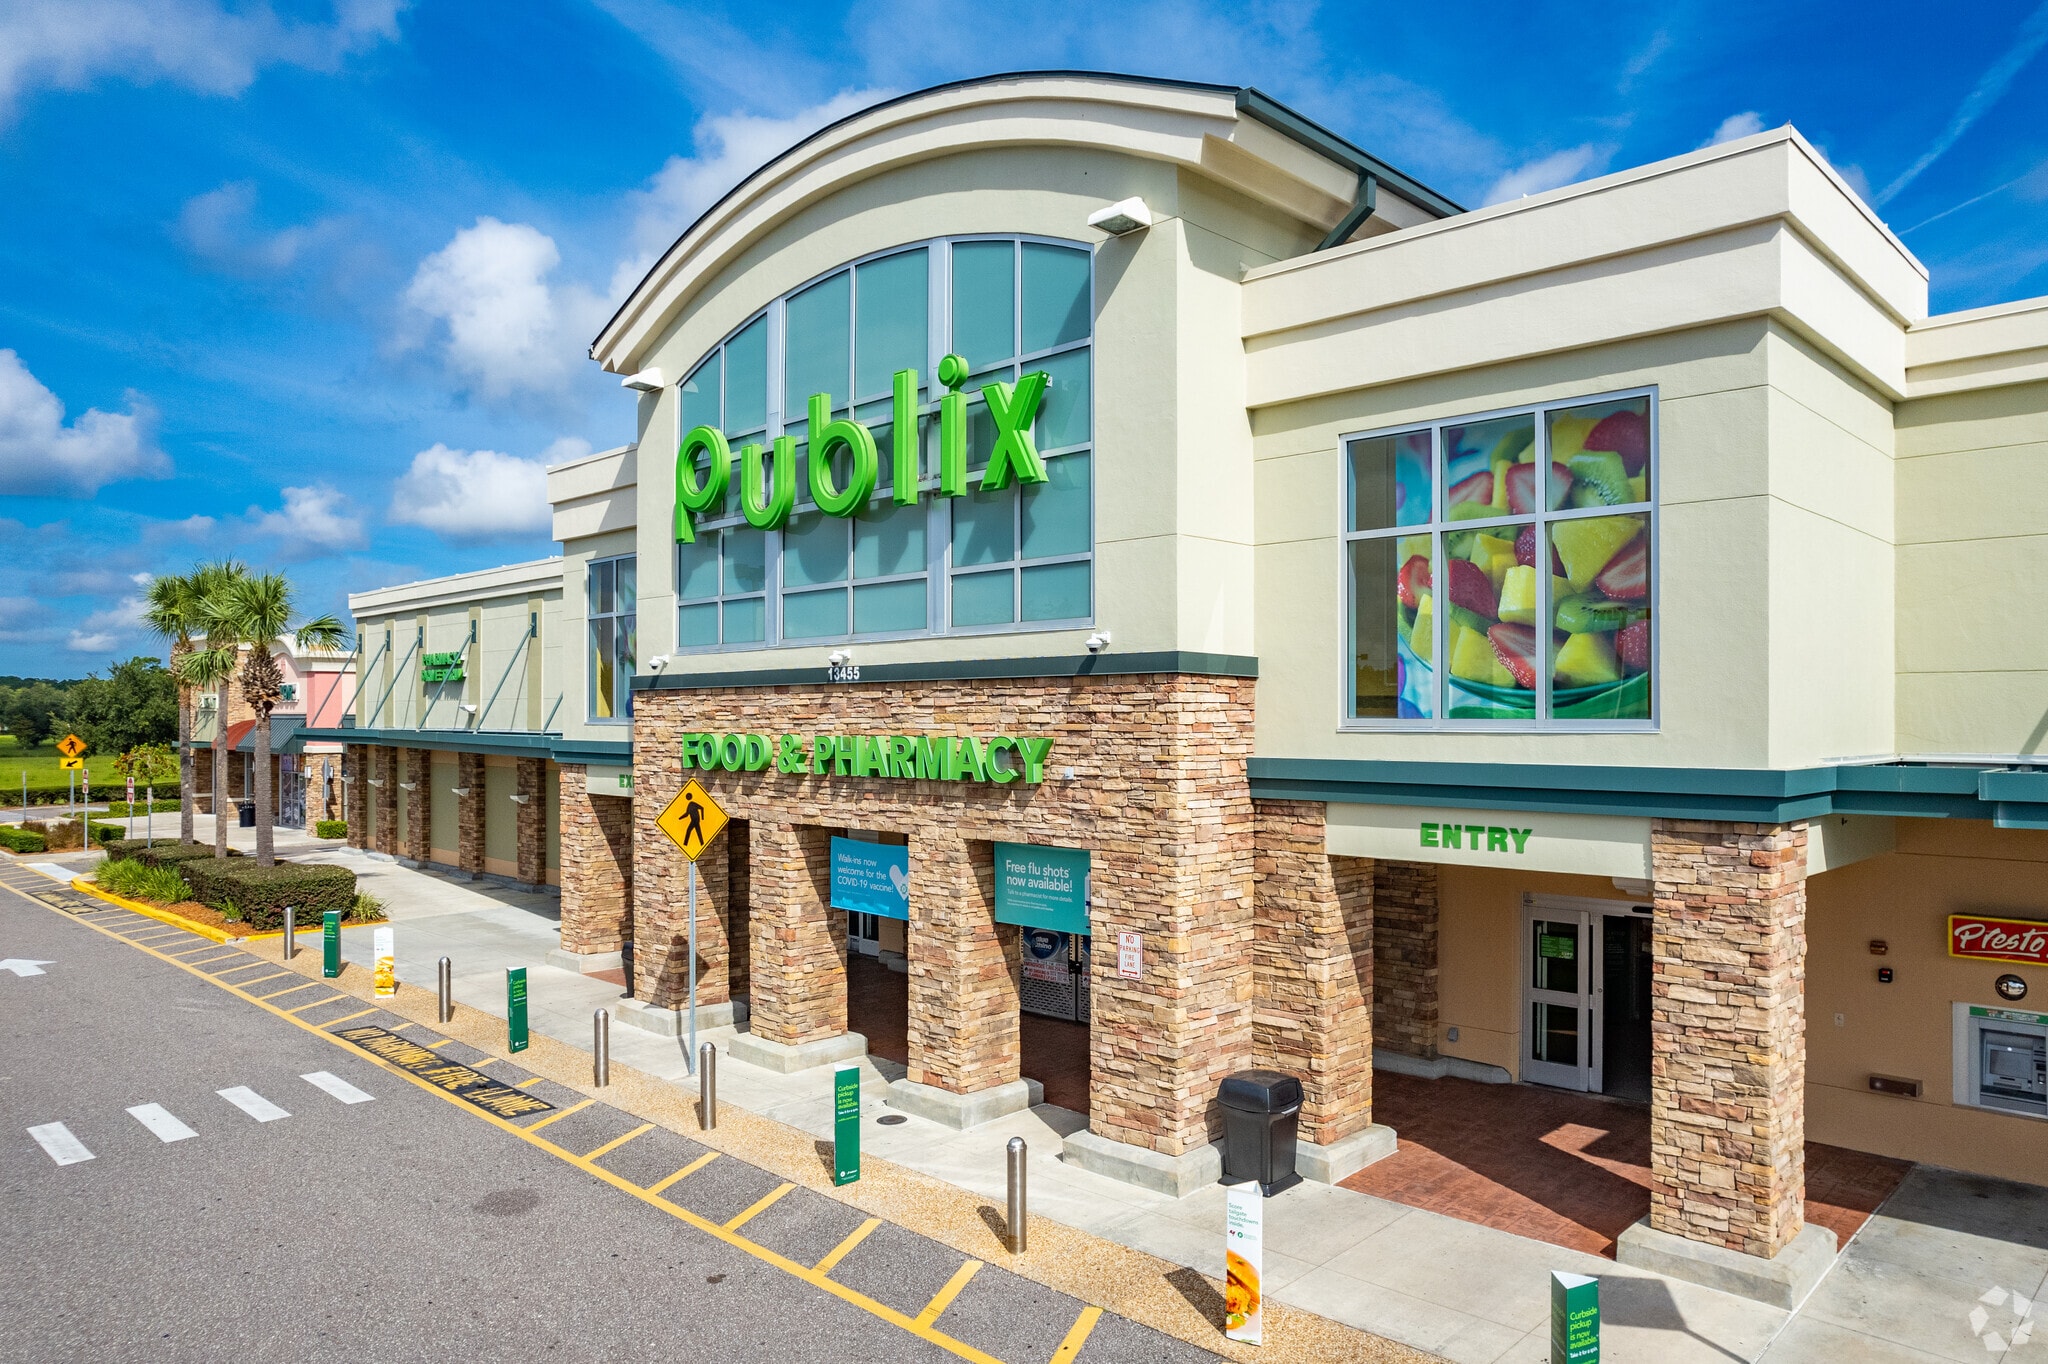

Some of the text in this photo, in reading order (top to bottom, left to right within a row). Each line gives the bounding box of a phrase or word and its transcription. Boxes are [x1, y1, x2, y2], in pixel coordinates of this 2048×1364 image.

[676, 353, 1050, 544] publix
[828, 666, 860, 681] 13455
[682, 732, 1054, 784] FOOD & PHARMACY
[619, 774, 635, 788] EX
[1420, 822, 1533, 854] ENTRY
[838, 853, 862, 865] Walk-ins
[837, 866, 887, 880] welcome for the
[1006, 860, 1026, 874] Free
[1028, 862, 1041, 875] flu
[837, 875, 868, 888] COVID-19
[869, 882, 894, 893] vaccine!
[1006, 876, 1073, 893] now available!
[1125, 935, 1135, 944] NO
[1954, 924, 2048, 957] Presto
[1120, 945, 1140, 953] PARKING
[1570, 1306, 1598, 1320] Curbside
[1570, 1320, 1592, 1333] pickup
[1576, 1330, 1591, 1339] now
